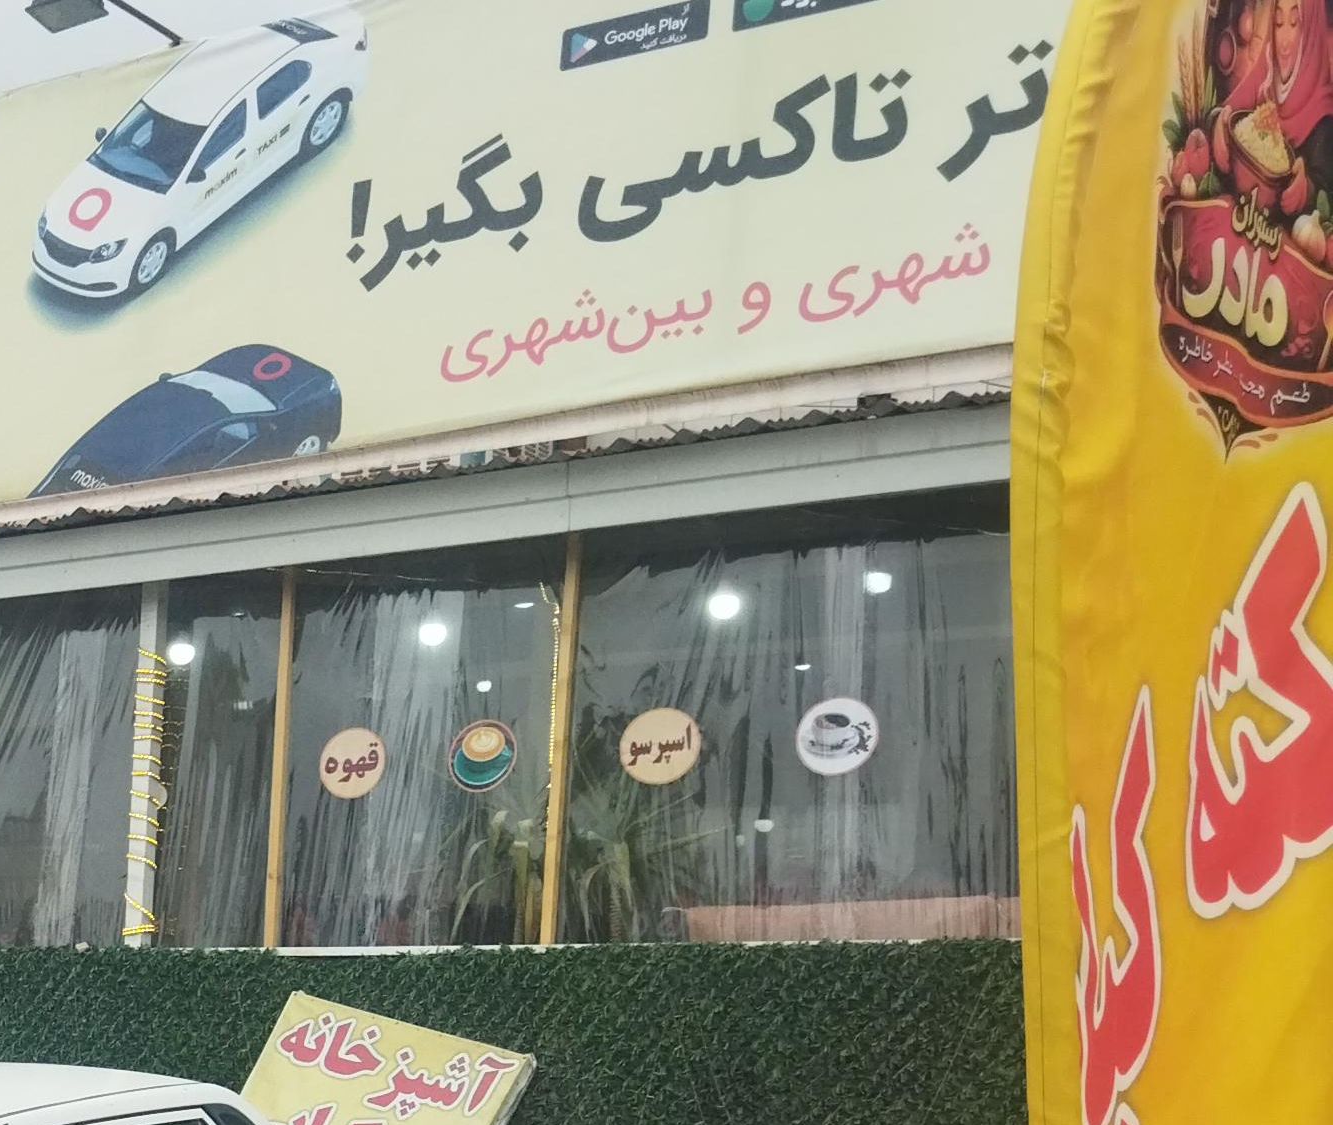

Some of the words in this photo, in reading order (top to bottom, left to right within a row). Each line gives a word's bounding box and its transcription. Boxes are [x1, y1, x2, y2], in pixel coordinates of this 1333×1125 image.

[604, 23, 656, 45] Google
[658, 17, 689, 33] Play
[576, 67, 912, 243] تاکسی
[345, 132, 544, 293] بگیر!
[1233, 187, 1282, 260] رستوران
[737, 279, 770, 333] و
[798, 221, 992, 324] شهری
[1182, 237, 1288, 346] مادر
[324, 742, 380, 782] قهوه
[626, 724, 692, 766] اسپرسو
[278, 1012, 518, 1118] آشپزخانه
